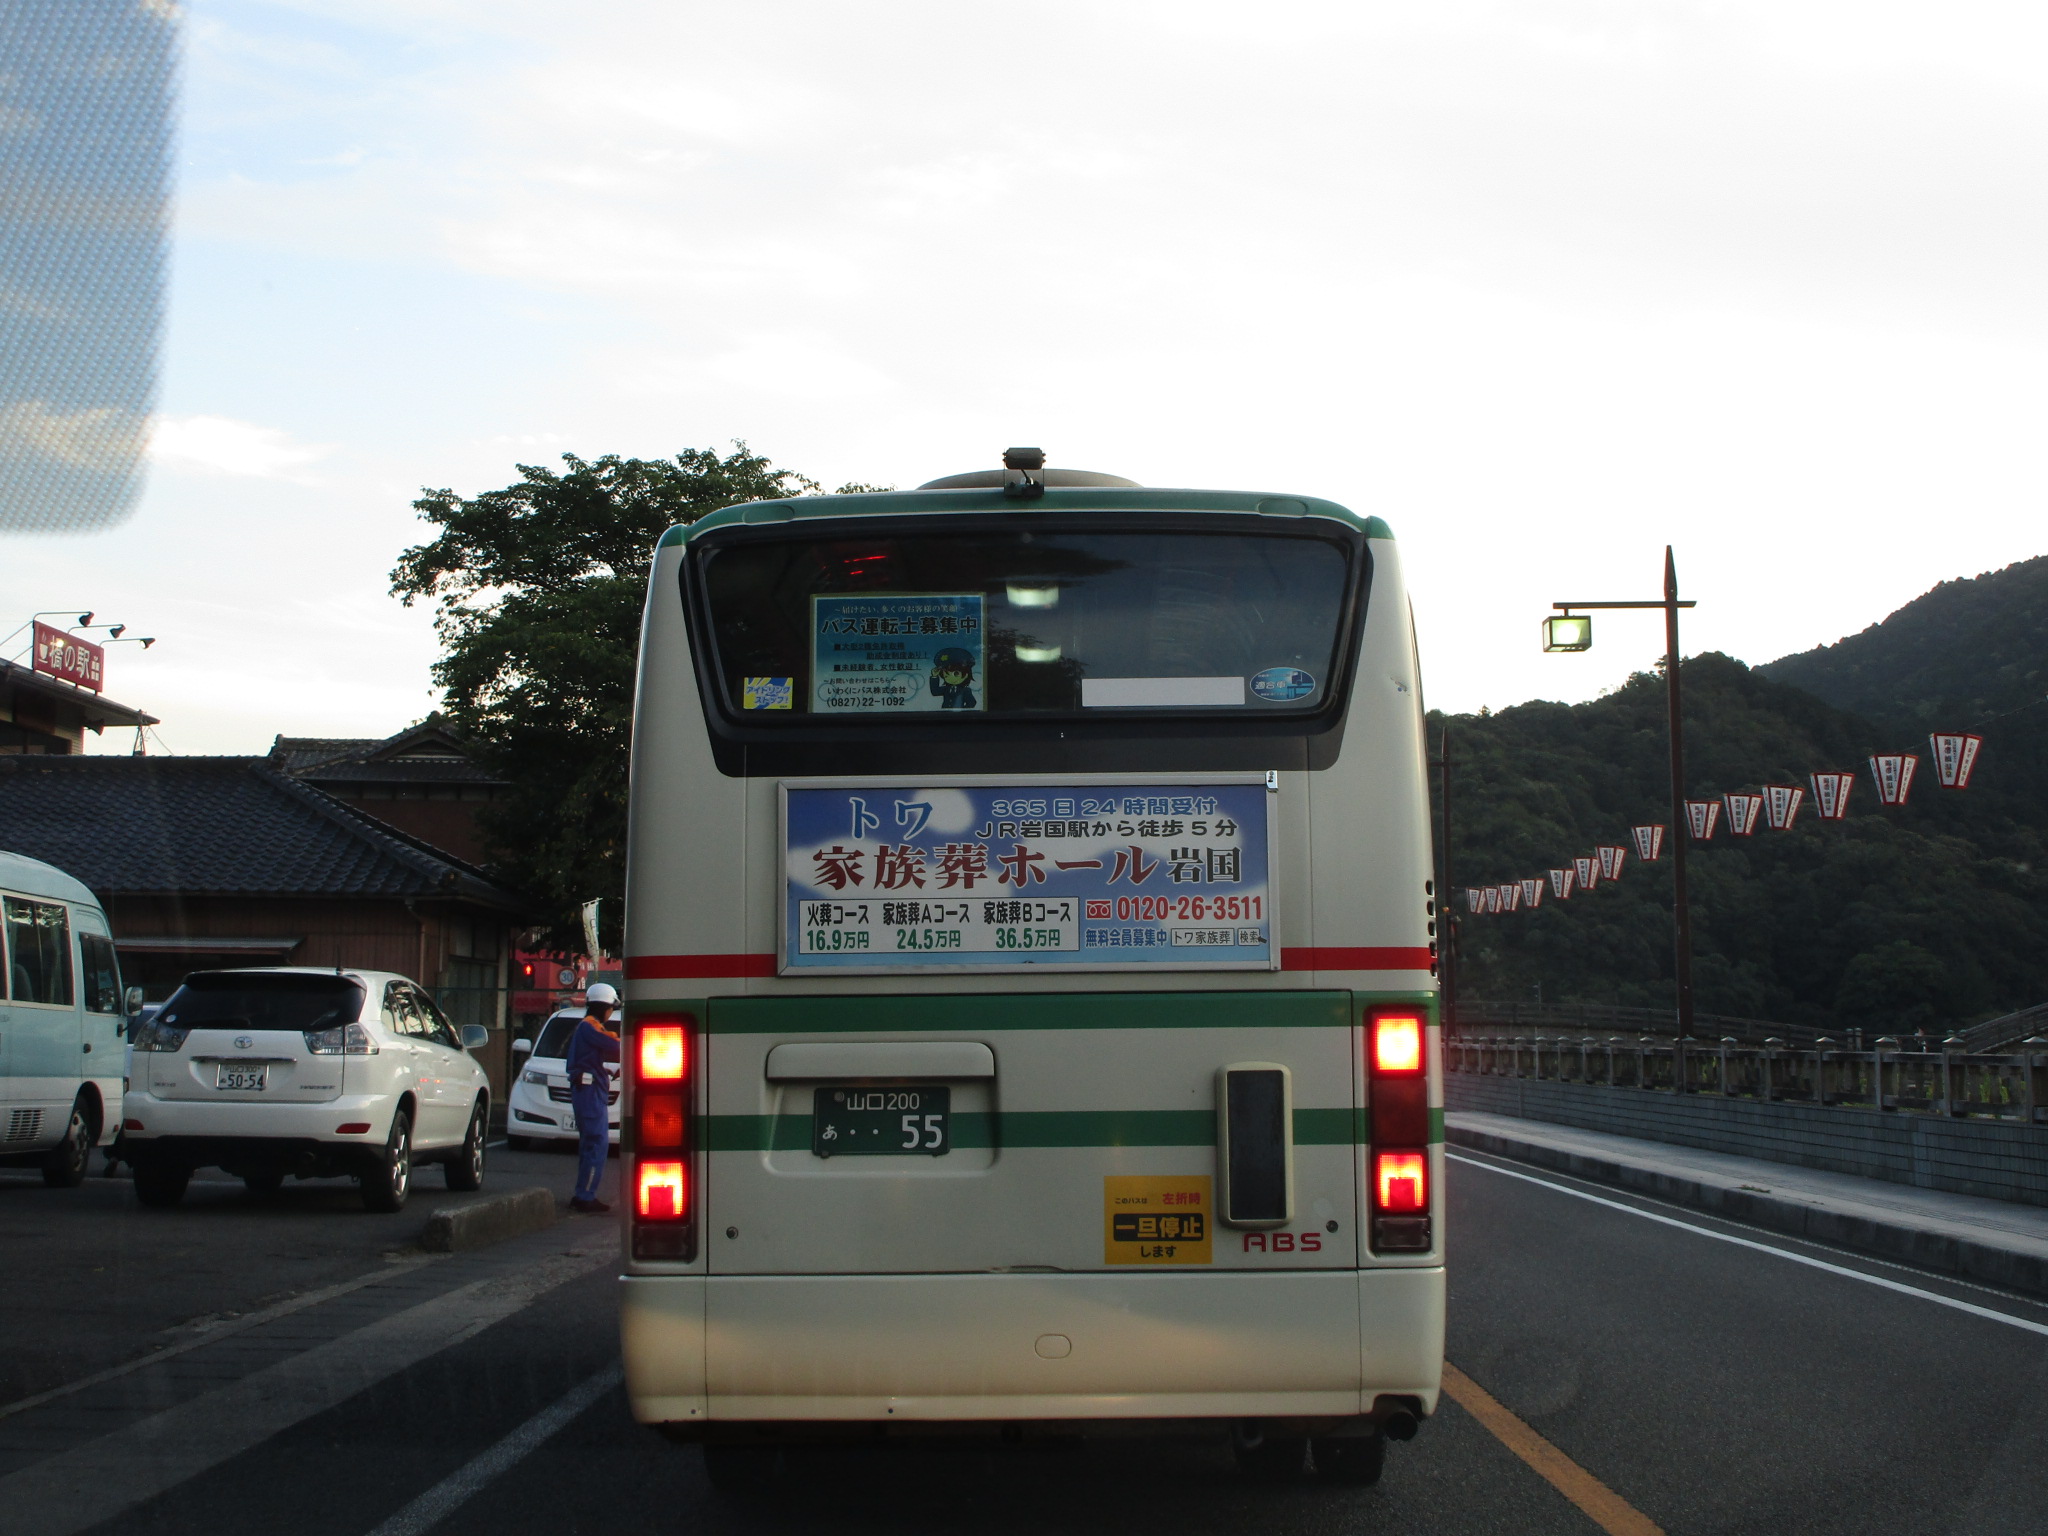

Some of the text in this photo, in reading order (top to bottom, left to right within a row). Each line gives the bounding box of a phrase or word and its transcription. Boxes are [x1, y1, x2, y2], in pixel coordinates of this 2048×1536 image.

[821, 616, 978, 636] バス運転士募集中
[827, 686, 907, 695] いわくにバス株式会社
[826, 697, 906, 707] (0827)22-1092
[850, 798, 933, 840] トワ
[807, 901, 1071, 926] 火葬コース 家族葬Aコース 家族葬Bコース
[1117, 896, 1262, 921] 0120-26-3511
[807, 928, 1061, 950] 16.9万円 24.5万円 36.5万円
[1086, 928, 1167, 947] 無料会員募集中
[1173, 931, 1258, 945] トワ家族葬 検索
[561, 972, 575, 980] 30
[227, 1074, 265, 1087] 50-54
[1162, 1192, 1201, 1205] 左折時
[1115, 1217, 1202, 1238] 一旦停止
[1141, 1245, 1177, 1258] します
[1243, 1232, 1323, 1252] ABS
